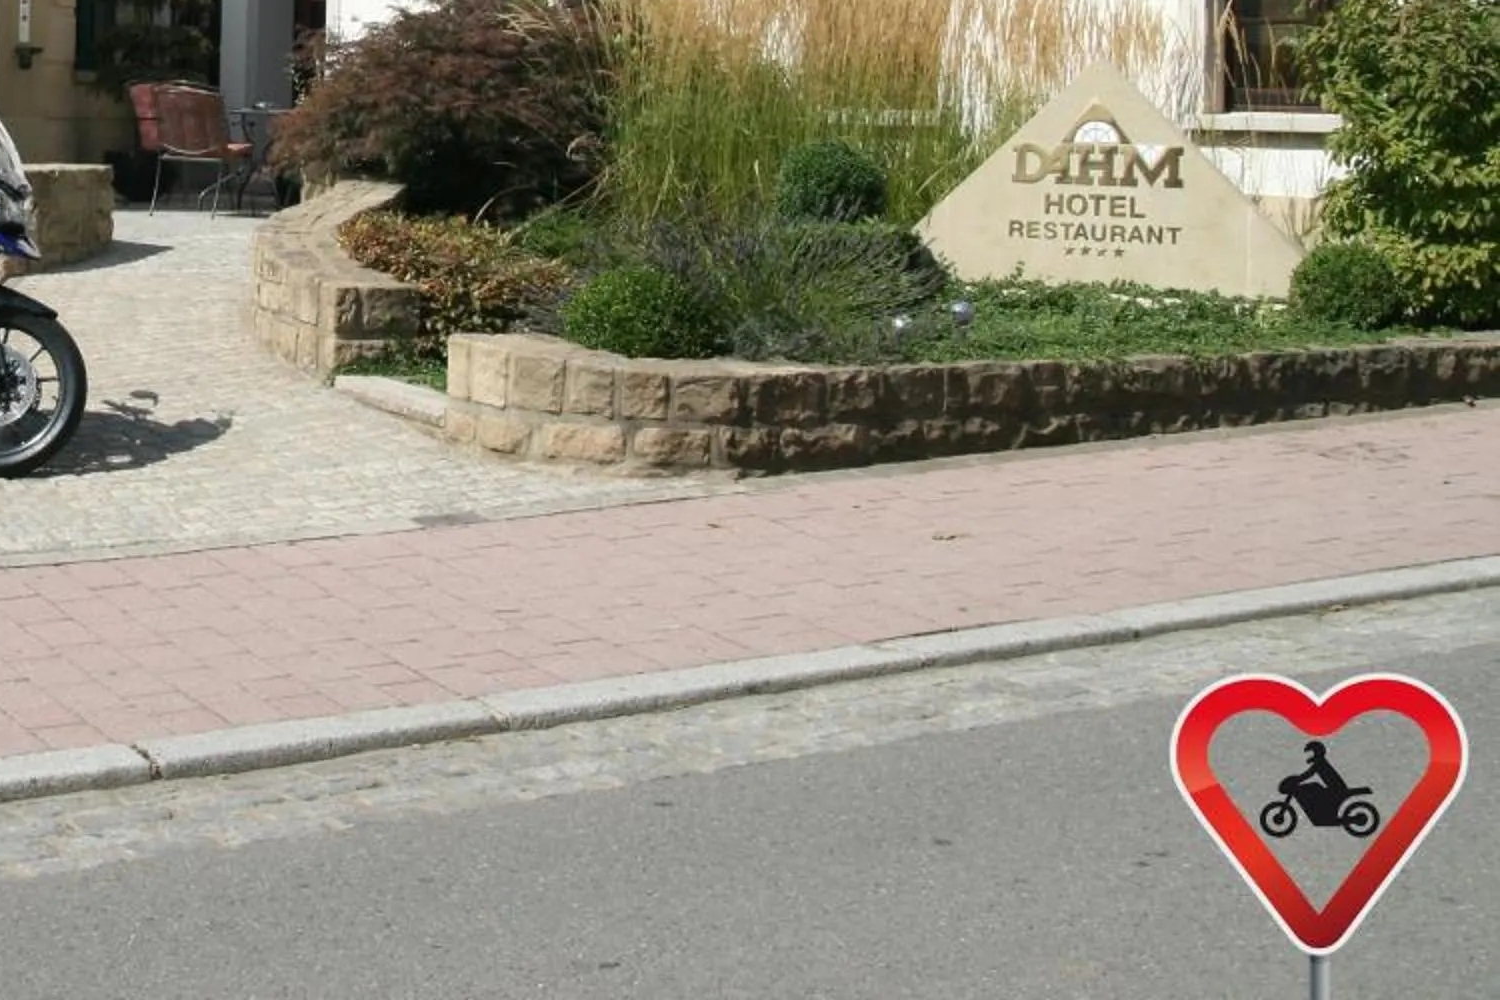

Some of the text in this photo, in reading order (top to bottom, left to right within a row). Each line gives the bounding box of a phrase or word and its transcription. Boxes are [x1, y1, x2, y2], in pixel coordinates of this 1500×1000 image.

[1012, 143, 1184, 188] DAHM
[1044, 193, 1146, 219] HOTEL
[1008, 220, 1182, 245] RESTAURANT
